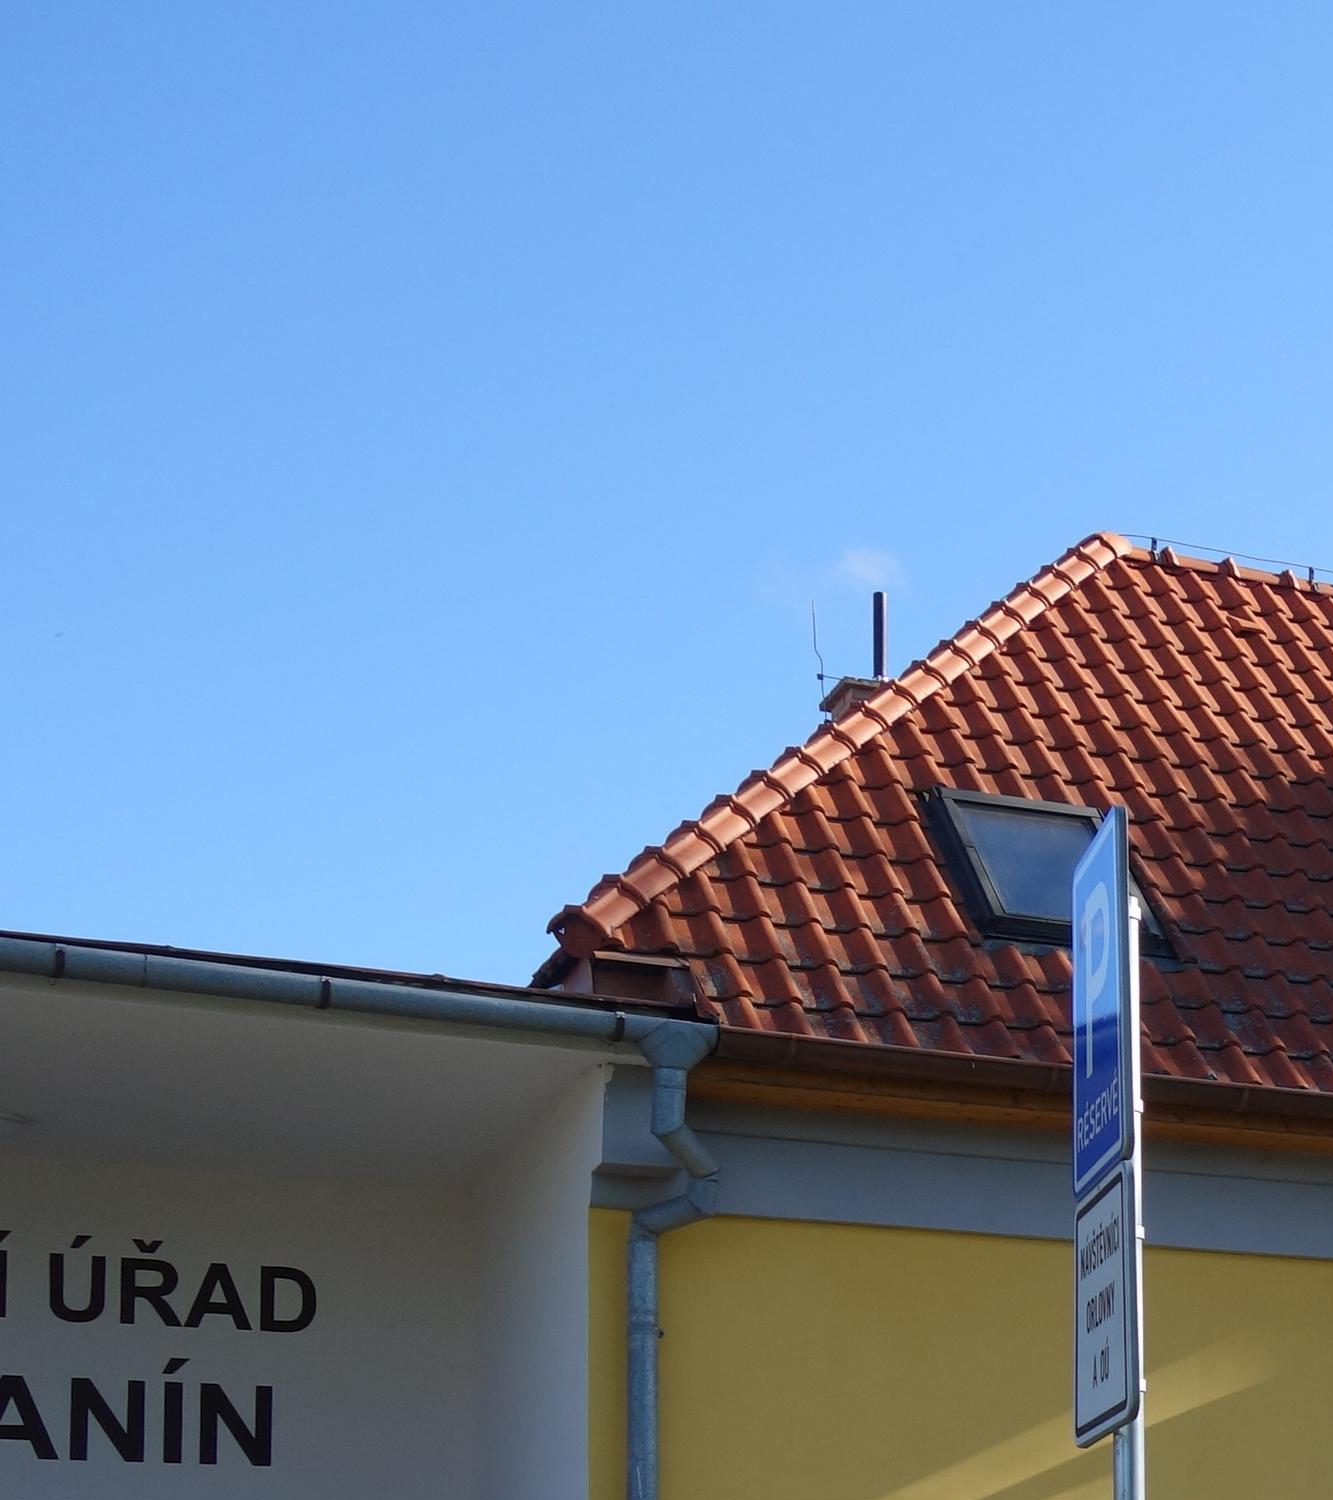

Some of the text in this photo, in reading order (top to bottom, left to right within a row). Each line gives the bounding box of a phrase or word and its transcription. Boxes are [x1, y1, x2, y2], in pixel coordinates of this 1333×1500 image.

[1086, 881, 1110, 1079] P
[1076, 1067, 1119, 1154] RÉSERVÉ
[49, 1235, 318, 1333] ÚŘAD
[1080, 1212, 1120, 1280] NÁVŠTĚVNÍCI
[1086, 1279, 1115, 1334] ORLOVNY
[1092, 1336, 1110, 1389] A OÚ
[0, 1357, 274, 1467] ANÍN
